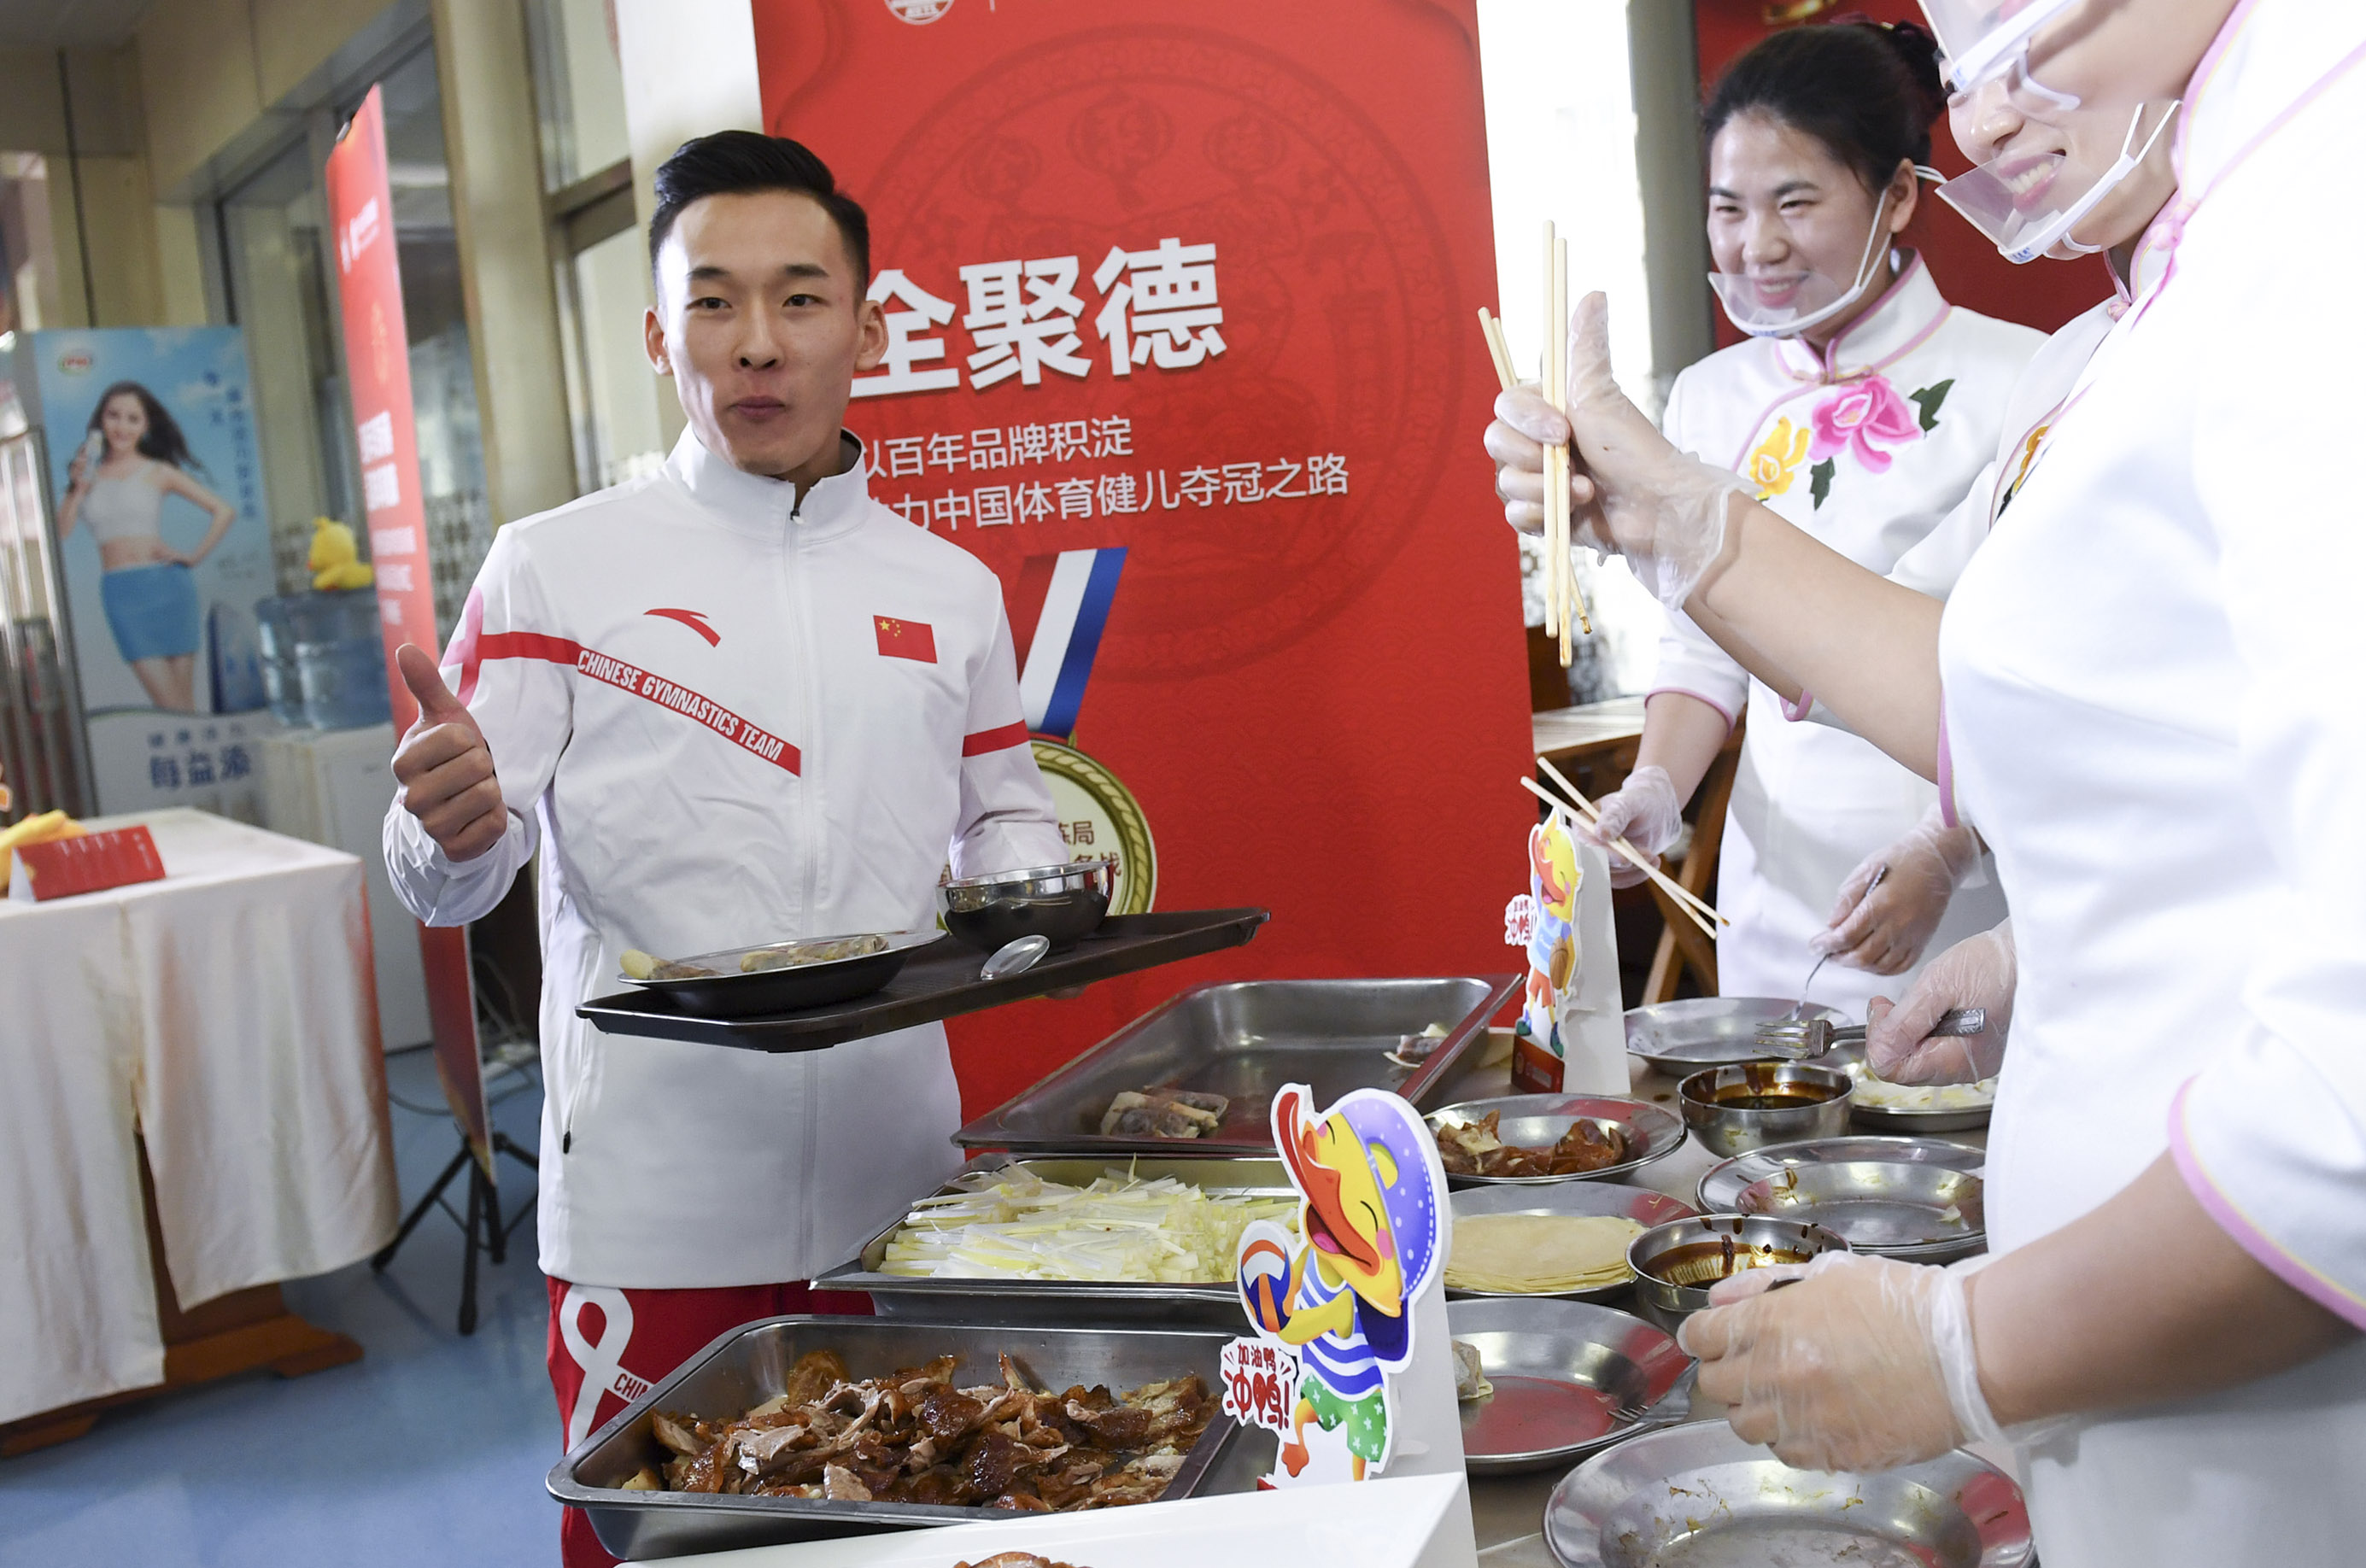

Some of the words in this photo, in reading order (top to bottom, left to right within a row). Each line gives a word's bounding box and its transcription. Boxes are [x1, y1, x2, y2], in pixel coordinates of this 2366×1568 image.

[848, 237, 1227, 398] 全聚德
[874, 453, 1350, 530] 力中国体育健儿夺冠之路
[577, 650, 642, 691] CHINESE
[641, 676, 740, 737] GYMNASTICS
[739, 723, 785, 762] TEAM
[1237, 1343, 1276, 1372] 加油鸭
